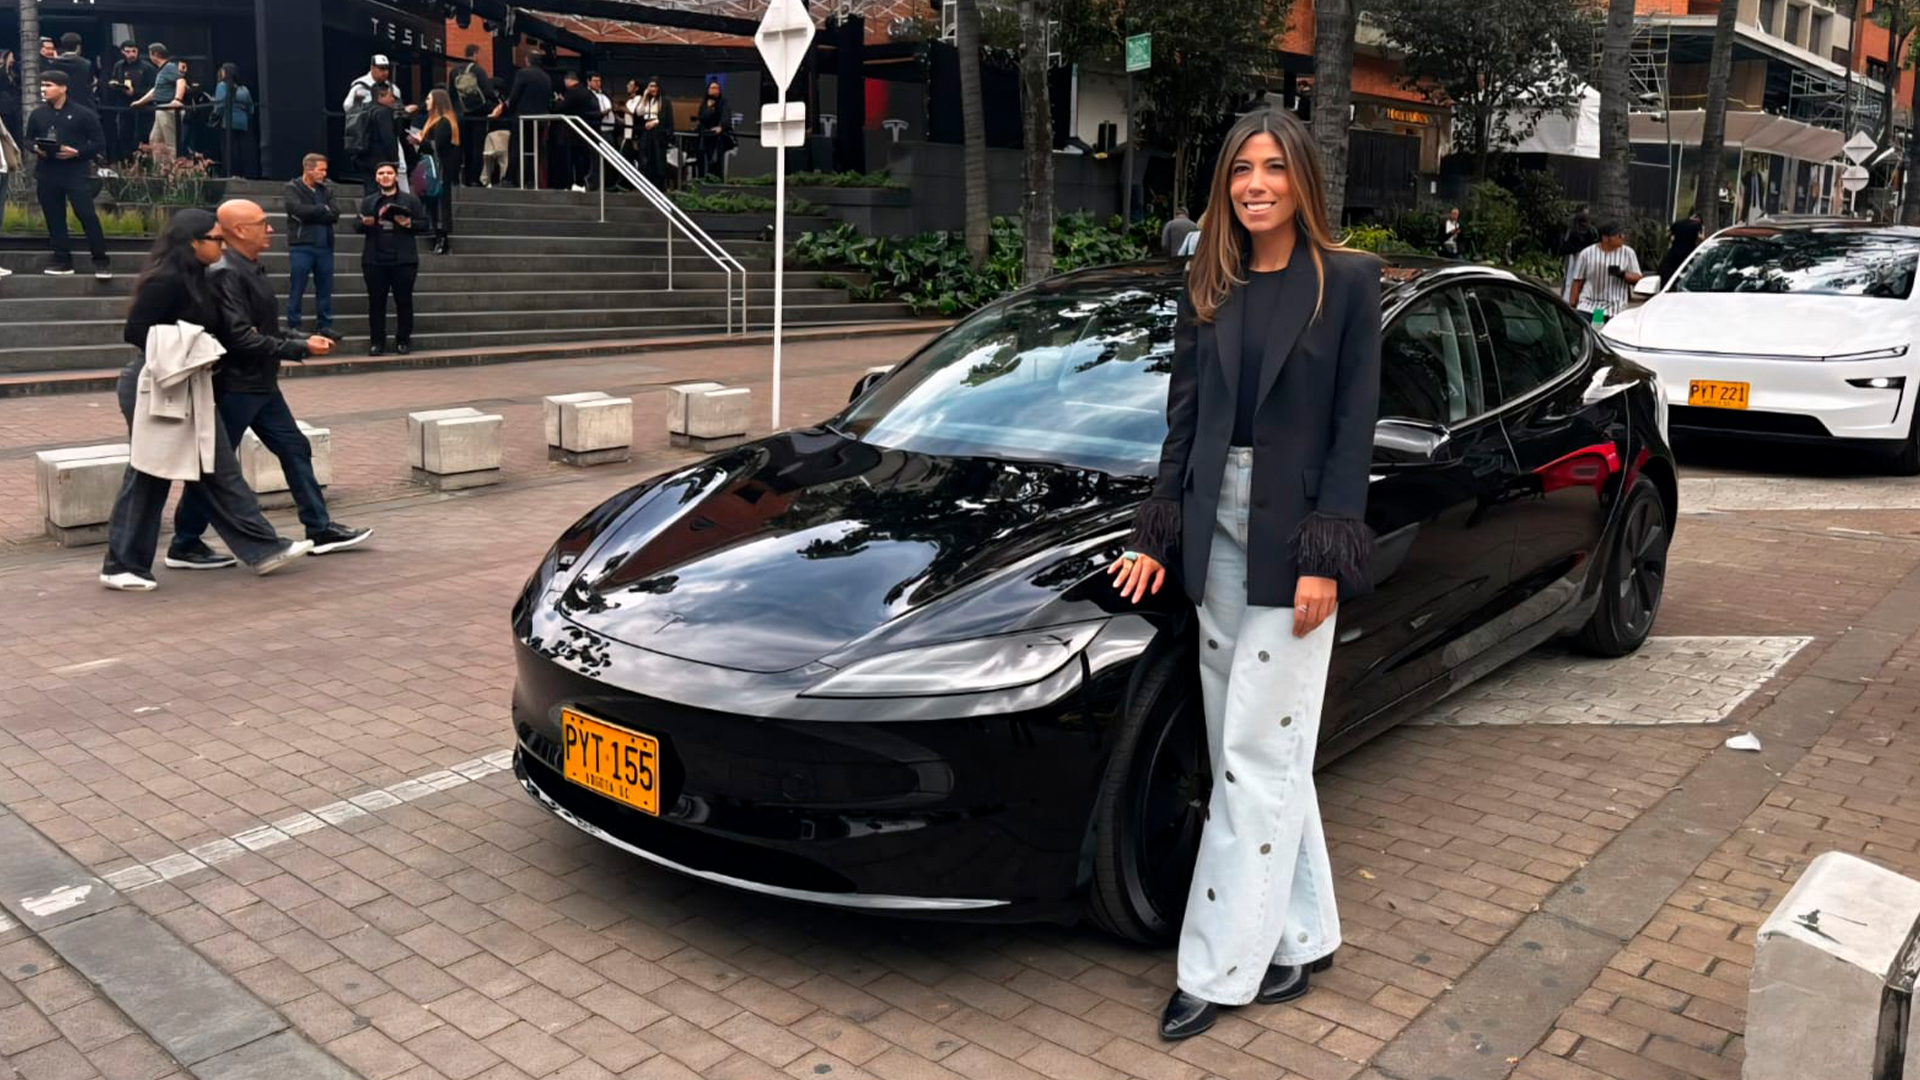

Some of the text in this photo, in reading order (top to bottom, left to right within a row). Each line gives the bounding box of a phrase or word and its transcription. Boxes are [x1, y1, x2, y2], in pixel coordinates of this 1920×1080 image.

[371, 17, 442, 53] TESLA
[1690, 384, 1744, 402] PYT 221
[566, 724, 653, 791] PYT 155
